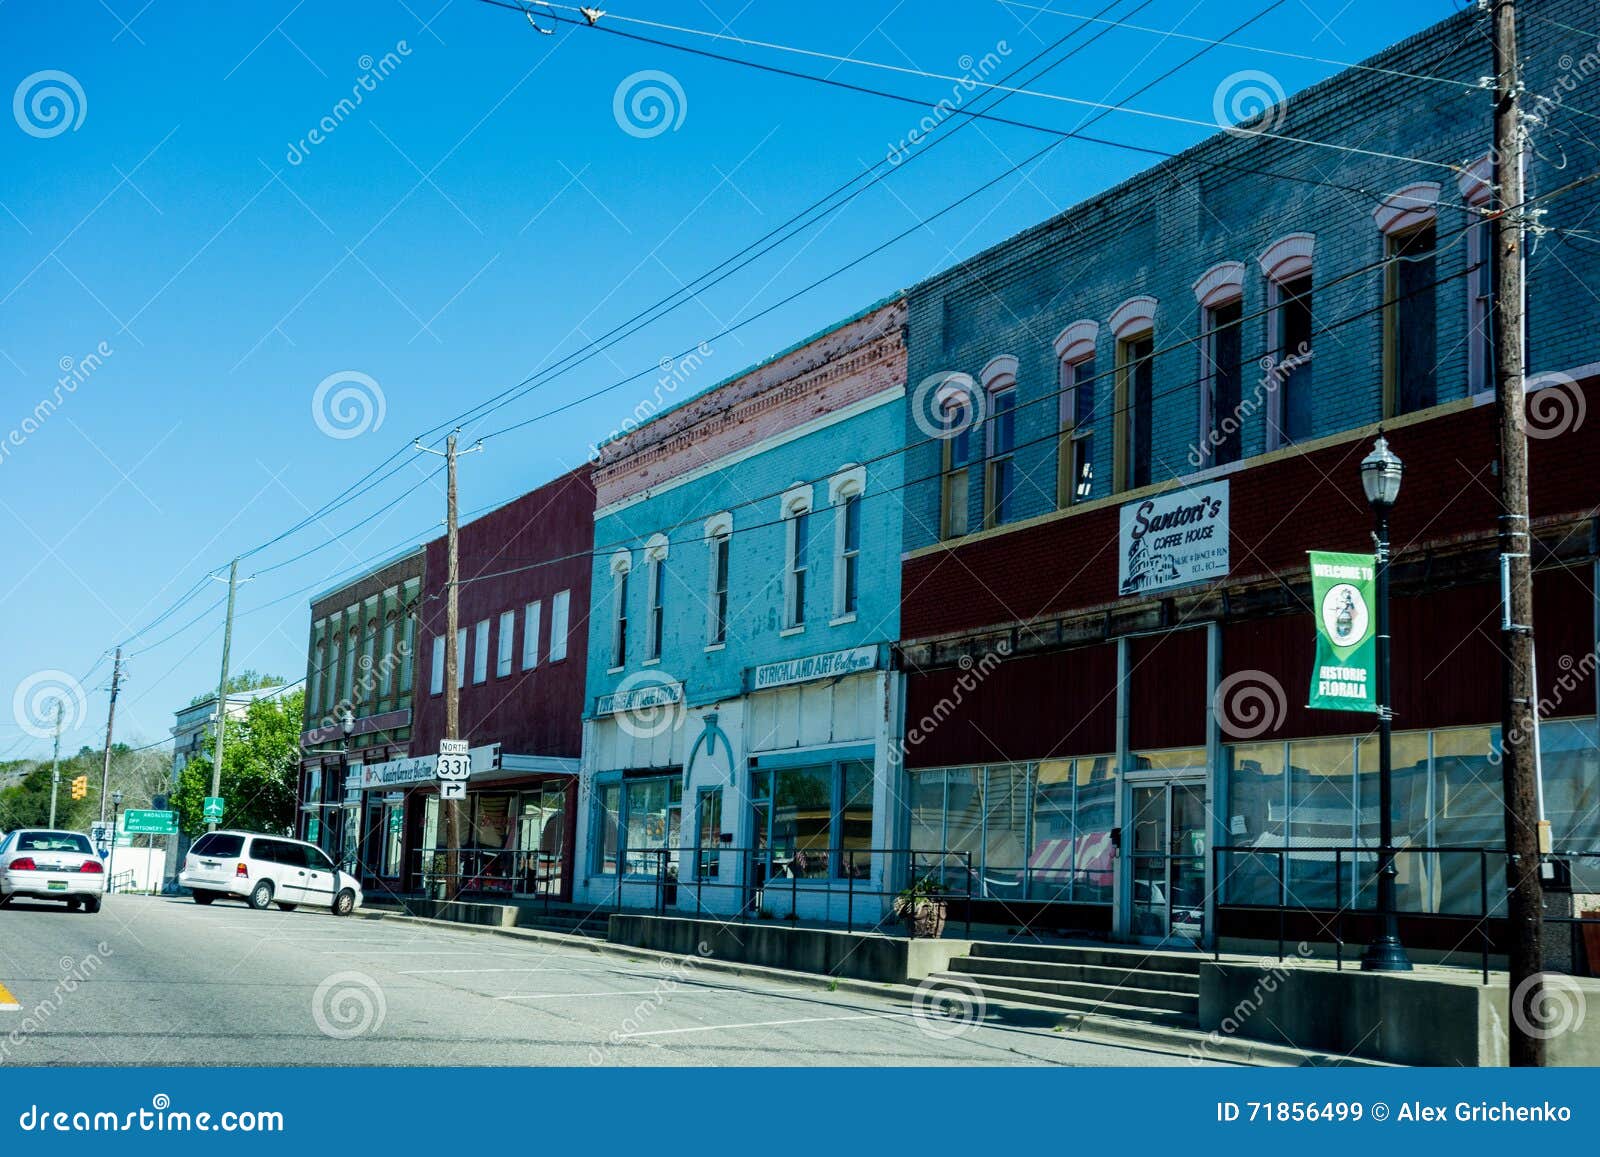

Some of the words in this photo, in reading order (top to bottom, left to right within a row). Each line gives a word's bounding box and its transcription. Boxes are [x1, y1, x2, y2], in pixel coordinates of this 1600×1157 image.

[1131, 496, 1222, 540] Santori's
[1153, 532, 1183, 551] COFFEE
[1185, 524, 1214, 543] HOUSE
[1313, 564, 1361, 580] WELCOME
[1361, 567, 1373, 581] TO
[759, 659, 814, 685] STRICKLAND
[813, 654, 835, 675] ART
[1320, 666, 1367, 682] HISTORIC
[1319, 681, 1367, 699] FLORALA
[442, 743, 467, 752] NORTH
[440, 760, 467, 775] 331
